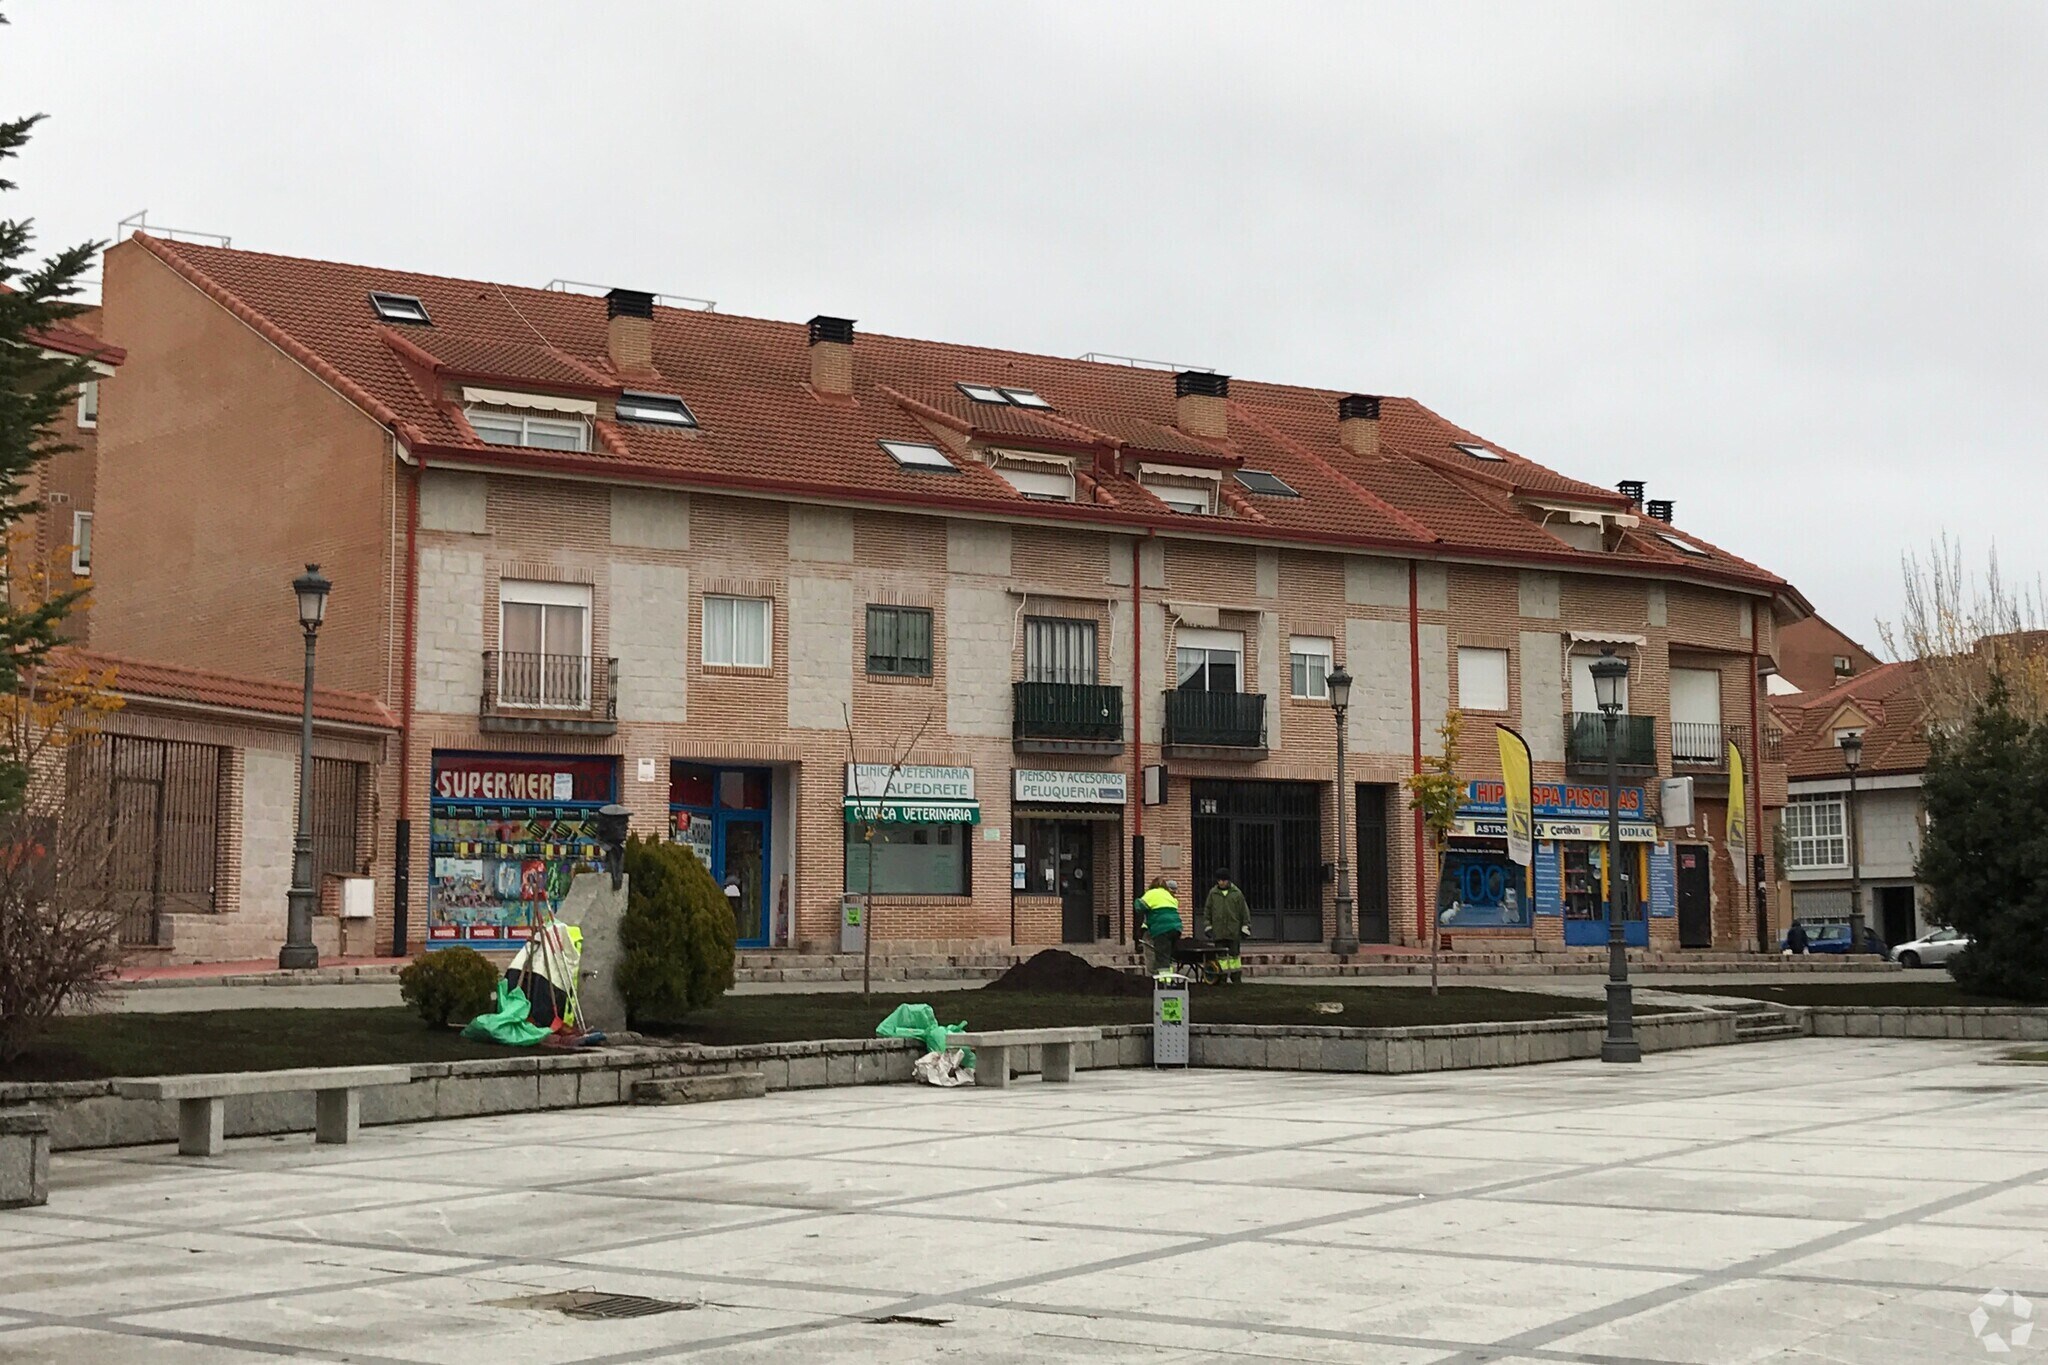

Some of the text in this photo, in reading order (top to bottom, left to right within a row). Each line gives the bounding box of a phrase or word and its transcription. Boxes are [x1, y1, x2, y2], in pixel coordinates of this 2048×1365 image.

[899, 766, 970, 780] VETERINARIA
[1019, 770, 1123, 785] PIENSOS Y ACCESORIOS
[887, 782, 968, 796] ALPEDRETE
[1023, 785, 1098, 799] PELUQUERIA
[1475, 782, 1506, 805] HIP
[1565, 786, 1639, 811] PISCIAS
[854, 806, 972, 821] CLINCA VETERINARIA
[1475, 824, 1653, 839] ASTRA Certikin ODIAC
